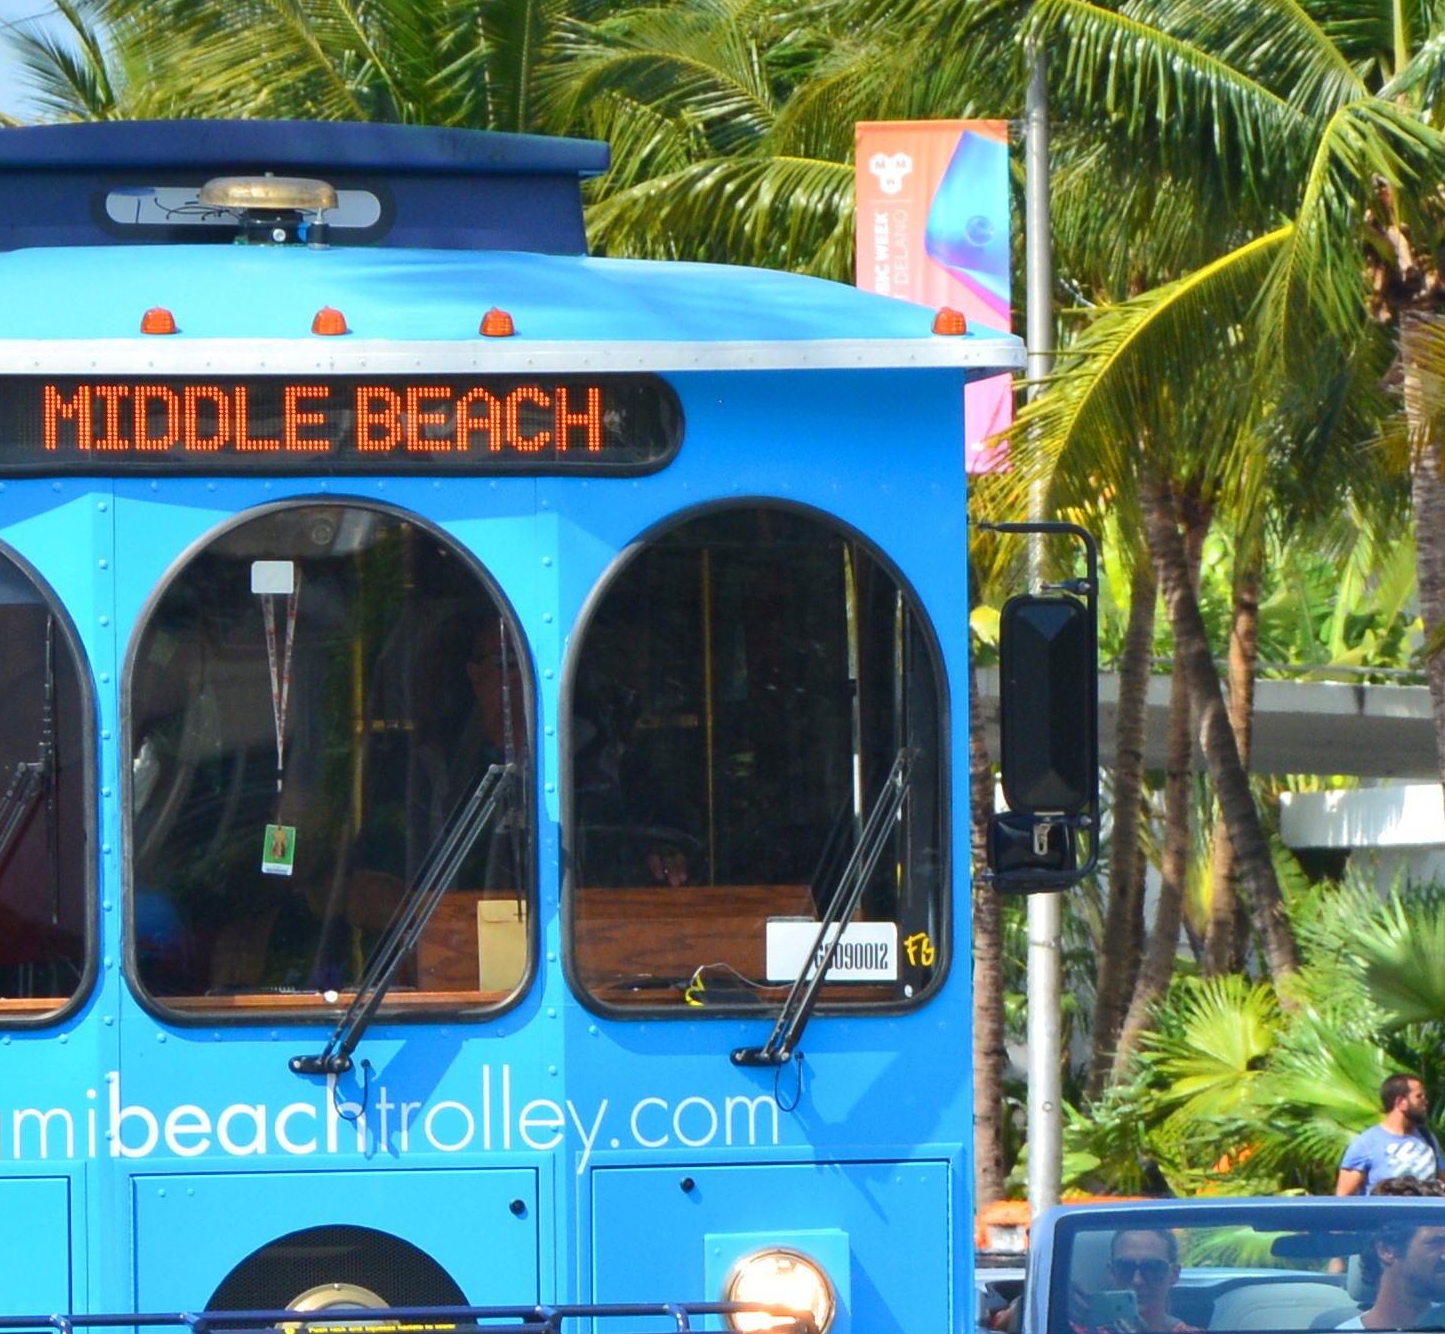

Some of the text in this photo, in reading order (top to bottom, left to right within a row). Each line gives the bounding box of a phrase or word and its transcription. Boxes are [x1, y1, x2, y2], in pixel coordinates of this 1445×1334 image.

[874, 211, 890, 262] WEEK
[893, 209, 909, 284] DELANO
[44, 385, 601, 452] MIDDLE BEACH
